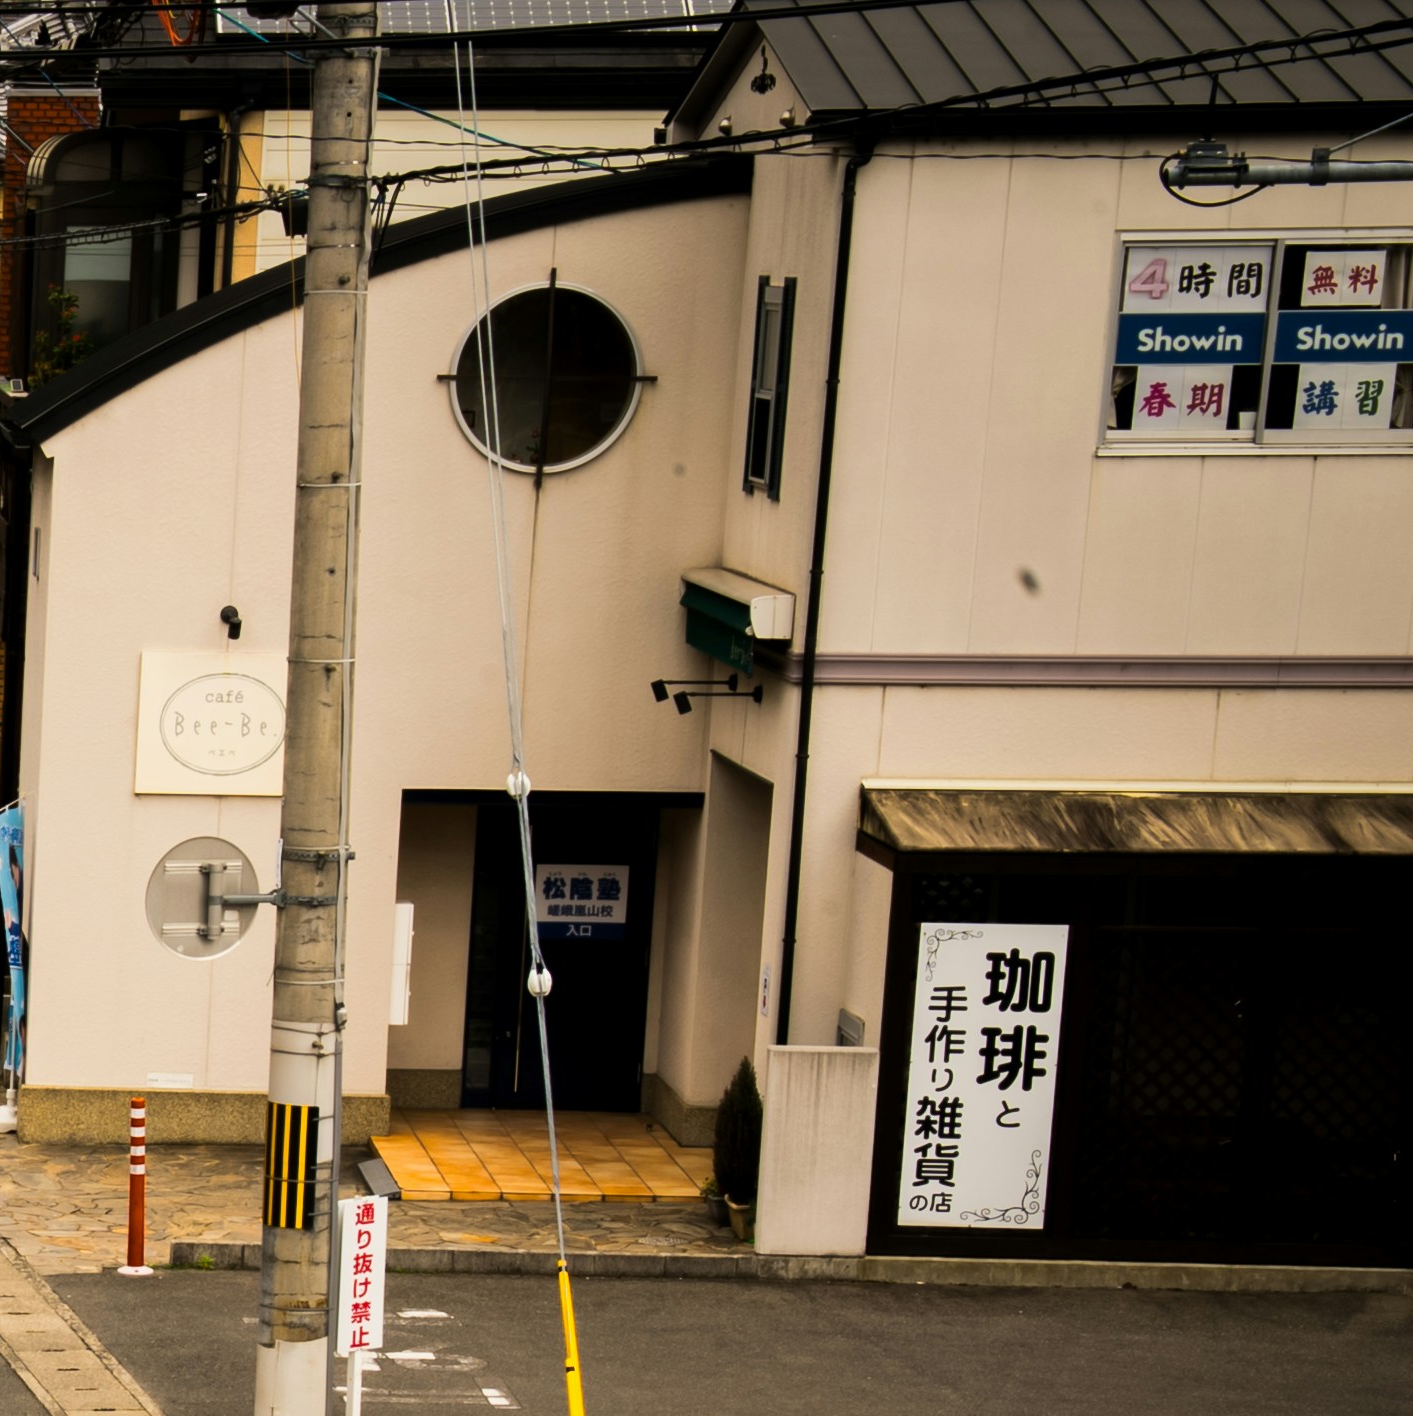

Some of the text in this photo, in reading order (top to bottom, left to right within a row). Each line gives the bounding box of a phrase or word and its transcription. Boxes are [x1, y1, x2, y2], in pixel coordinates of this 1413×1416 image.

[1128, 257, 1264, 300] 4時間
[1306, 263, 1380, 297] 無料
[1137, 325, 1243, 353] Showin
[1296, 323, 1404, 351] Showin
[1137, 381, 1226, 418] 春期
[1302, 379, 1384, 417] 講習
[204, 690, 244, 704] café
[542, 876, 621, 901] 松陰塾
[566, 924, 592, 937] 入口
[976, 947, 1056, 1128] 珈琲と
[909, 985, 969, 1213] 手作り雑貨の店
[349, 1203, 375, 1349] 通り抜け禁止
